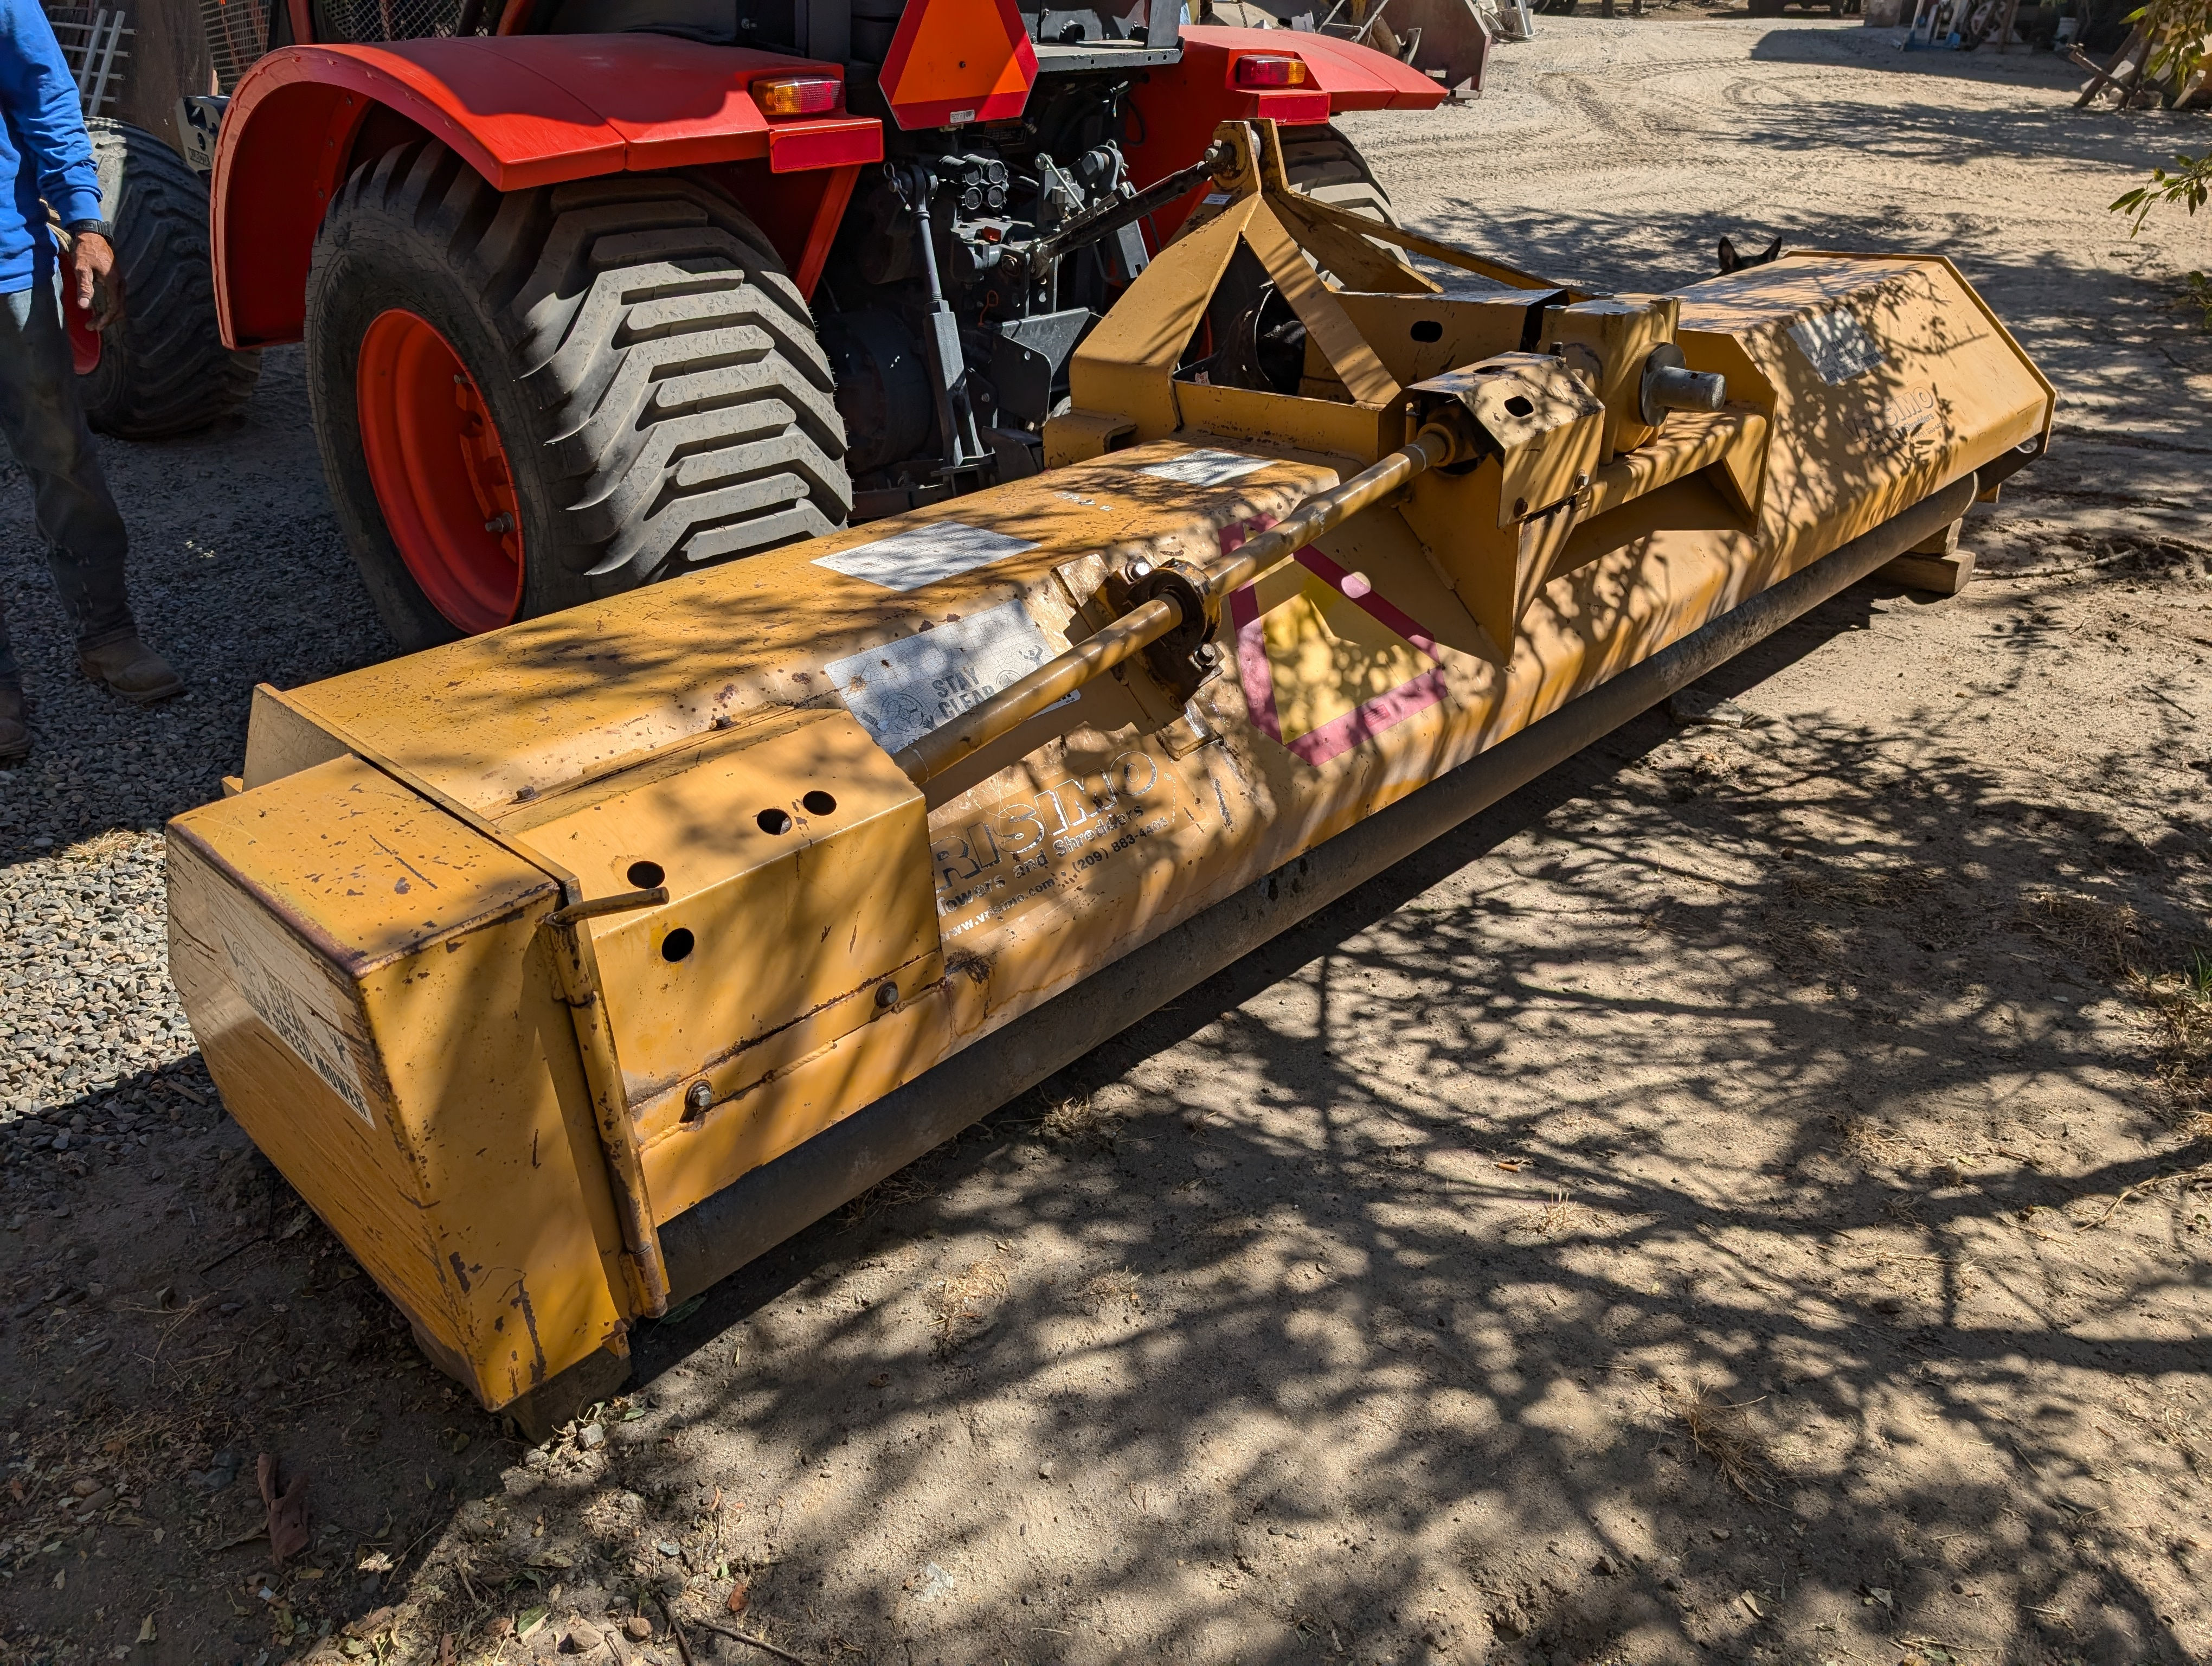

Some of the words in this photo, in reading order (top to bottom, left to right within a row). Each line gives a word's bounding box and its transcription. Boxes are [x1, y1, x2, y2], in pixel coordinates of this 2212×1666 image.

[1829, 339, 1846, 352] STAY
[933, 667, 980, 698] STAY
[1012, 848, 1049, 879] and
[1053, 805, 1144, 857] Shredders
[1072, 847, 1109, 873] (209)
[1111, 816, 1169, 852] 883-4405
[272, 1013, 313, 1064] SPEED
[314, 1052, 368, 1118] MOWER
